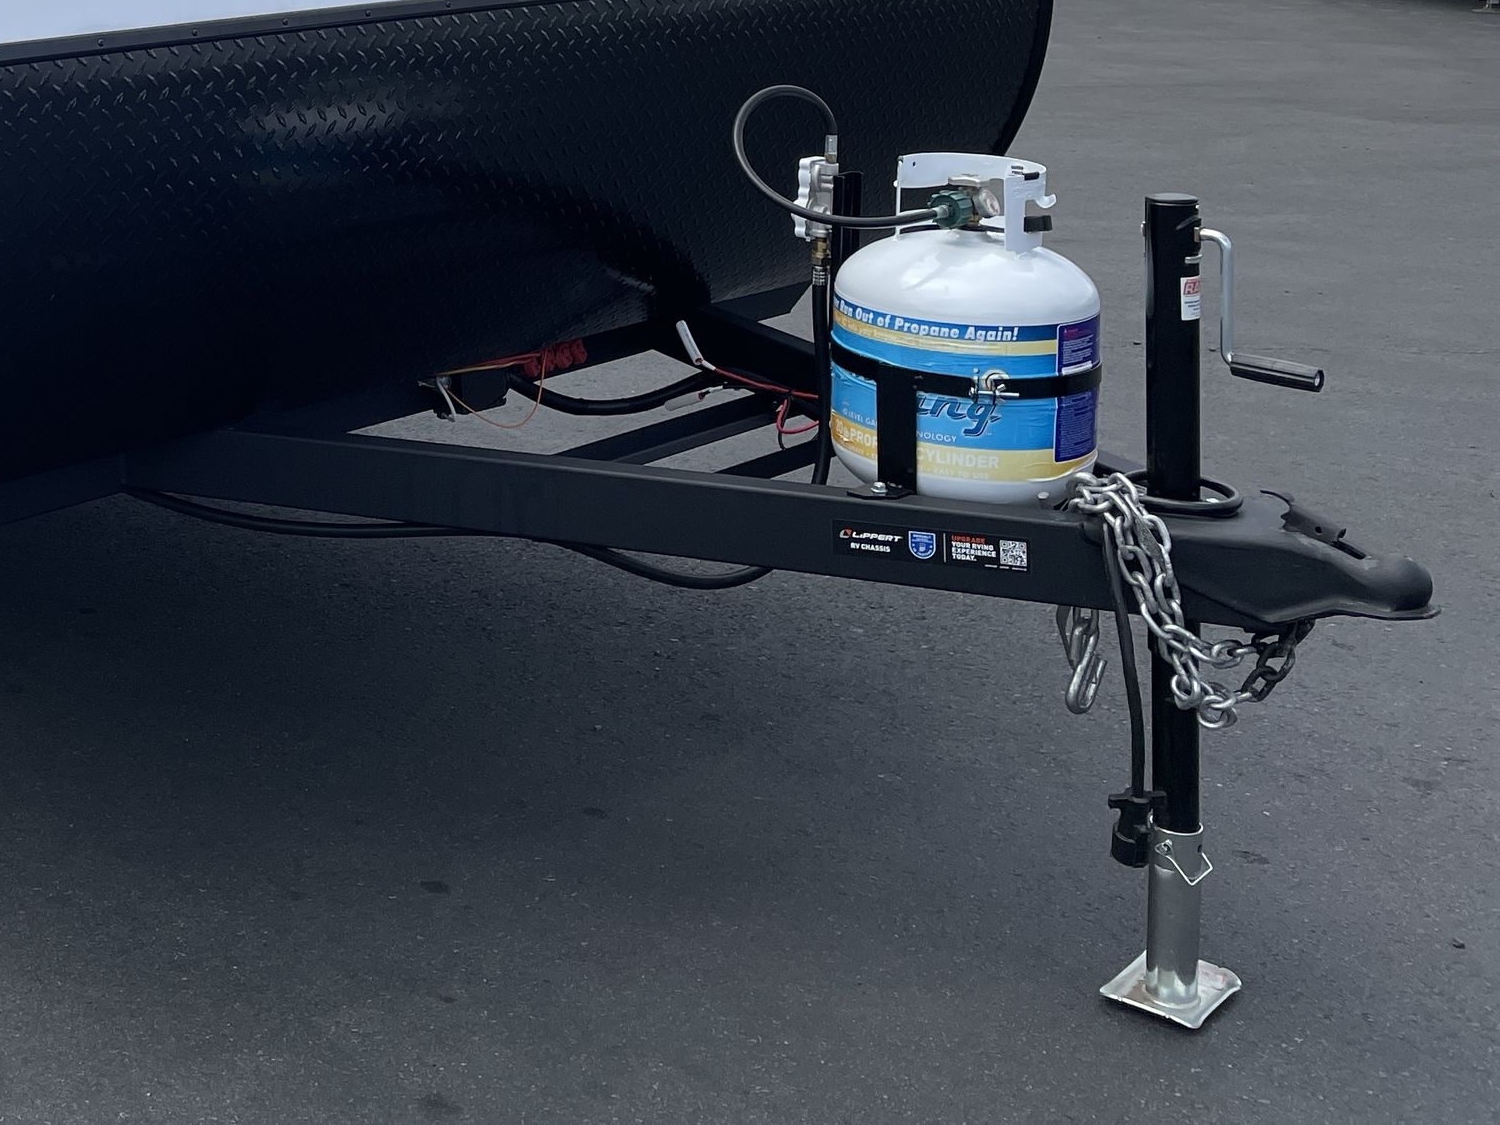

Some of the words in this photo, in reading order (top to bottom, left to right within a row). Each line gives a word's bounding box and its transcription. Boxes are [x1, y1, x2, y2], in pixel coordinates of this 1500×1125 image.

[840, 299, 853, 317] Run
[855, 307, 874, 324] Out
[877, 315, 891, 328] of
[894, 317, 960, 339] Propane
[964, 326, 1019, 342] Again!
[917, 431, 957, 443] NOLOGY
[852, 531, 903, 542] LIPPERT
[952, 535, 986, 544] UPGRADE
[861, 543, 891, 553] CHASSIS
[952, 541, 971, 549] YOUR
[972, 543, 994, 551] RVING
[952, 547, 997, 558] EXPERIENCE
[953, 553, 978, 562] TODAY.
